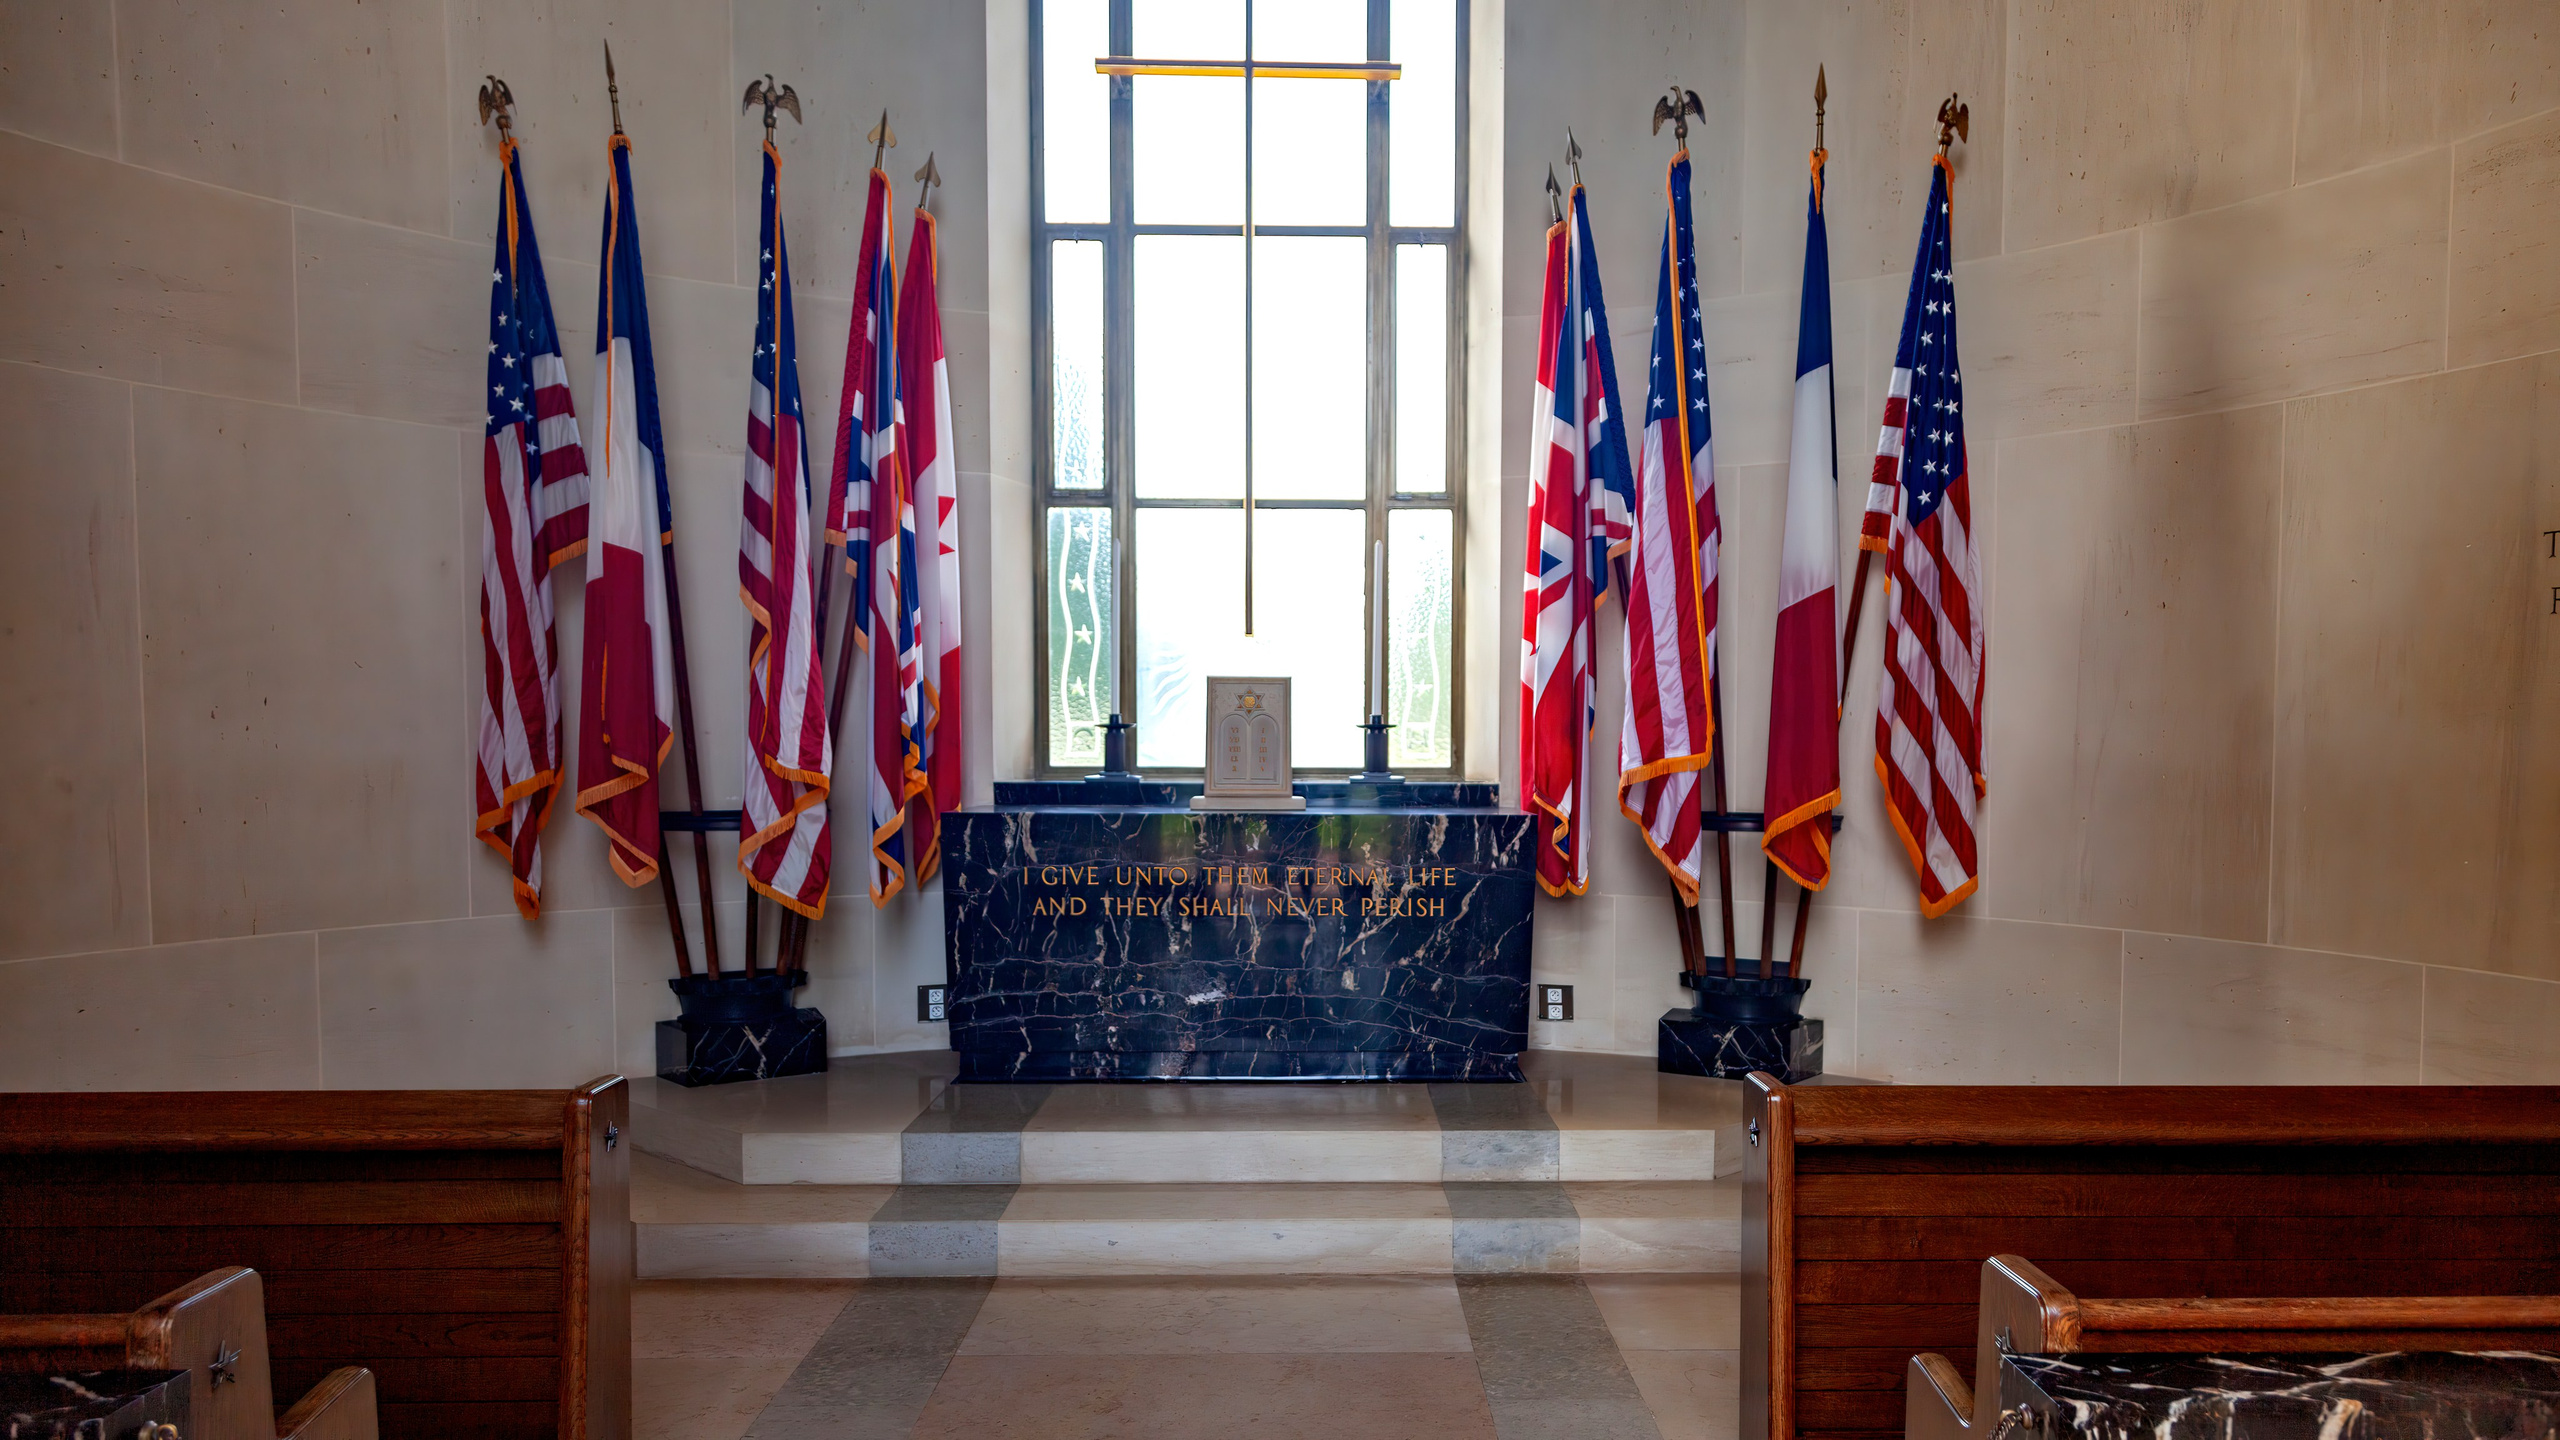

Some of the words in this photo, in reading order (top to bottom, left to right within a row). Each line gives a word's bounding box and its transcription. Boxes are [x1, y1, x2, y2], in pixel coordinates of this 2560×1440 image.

[1023, 866, 1029, 885] I
[1041, 866, 1099, 885] GIVE
[1116, 866, 1188, 885] UNTO
[1202, 867, 1269, 885] THEM
[1287, 867, 1394, 886] ETERNAL
[1408, 867, 1457, 886] LIFE
[1032, 897, 1087, 916] AND
[1100, 897, 1164, 916] THEY
[1178, 897, 1250, 917] SHALL
[1266, 897, 1348, 917] NEVER
[1360, 897, 1446, 917] PERISH
